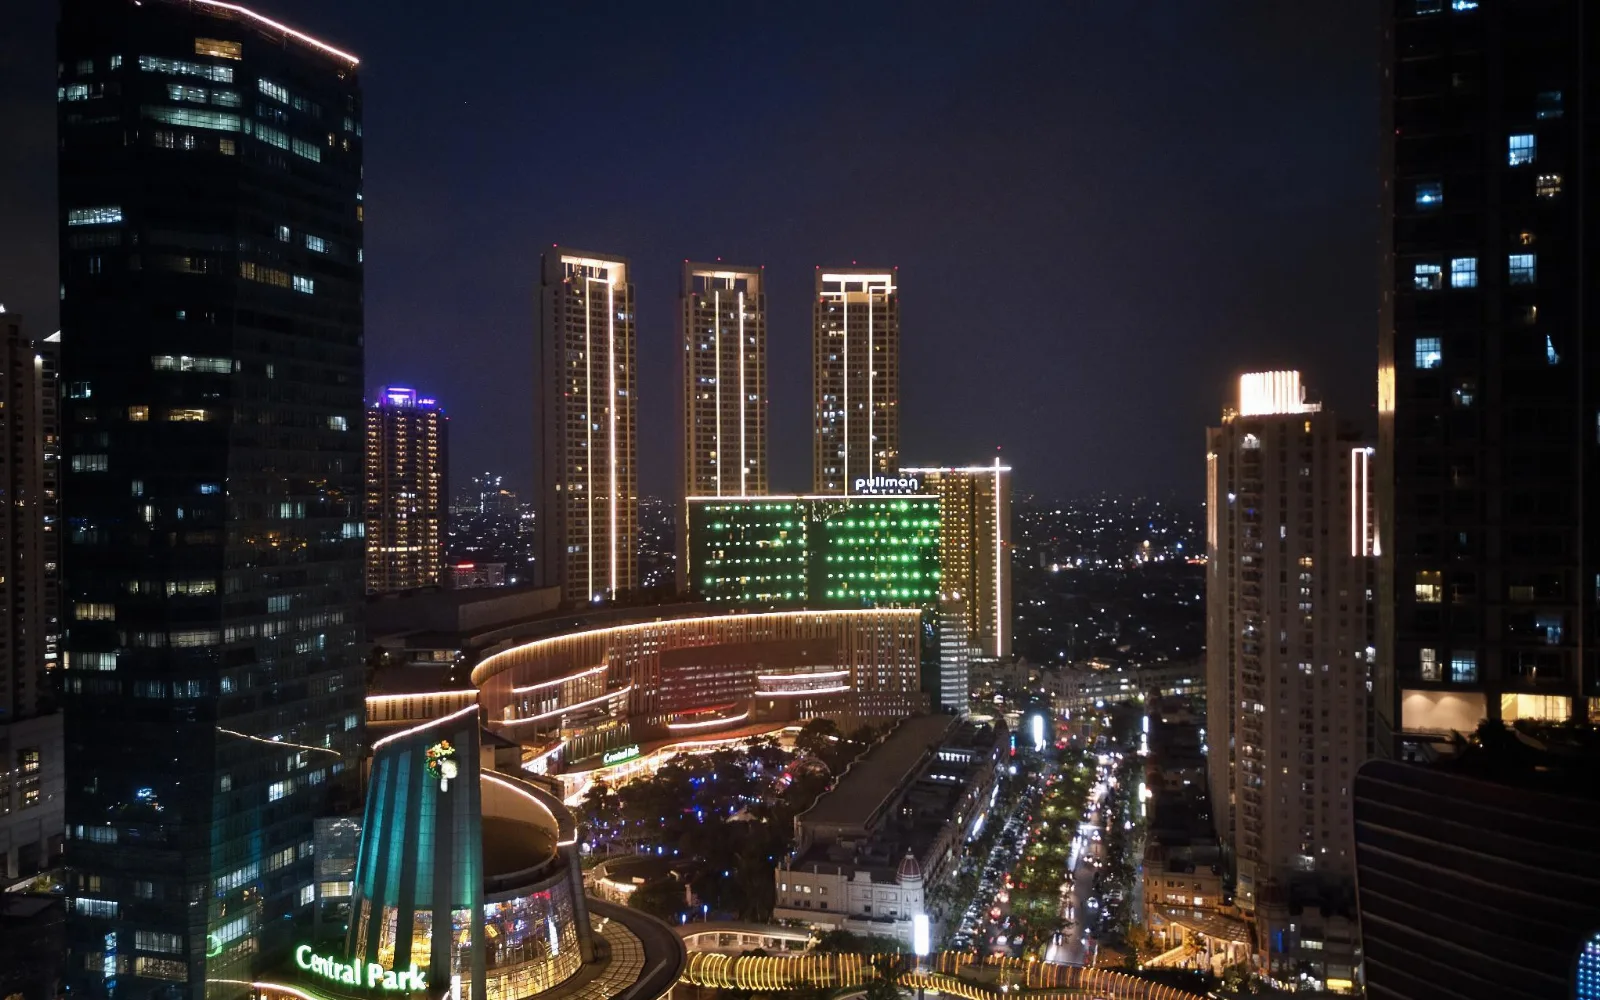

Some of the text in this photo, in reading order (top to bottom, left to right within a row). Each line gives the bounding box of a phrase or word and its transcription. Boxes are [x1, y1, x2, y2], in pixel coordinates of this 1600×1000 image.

[855, 476, 917, 491] pullman
[296, 944, 427, 990] Central Park
